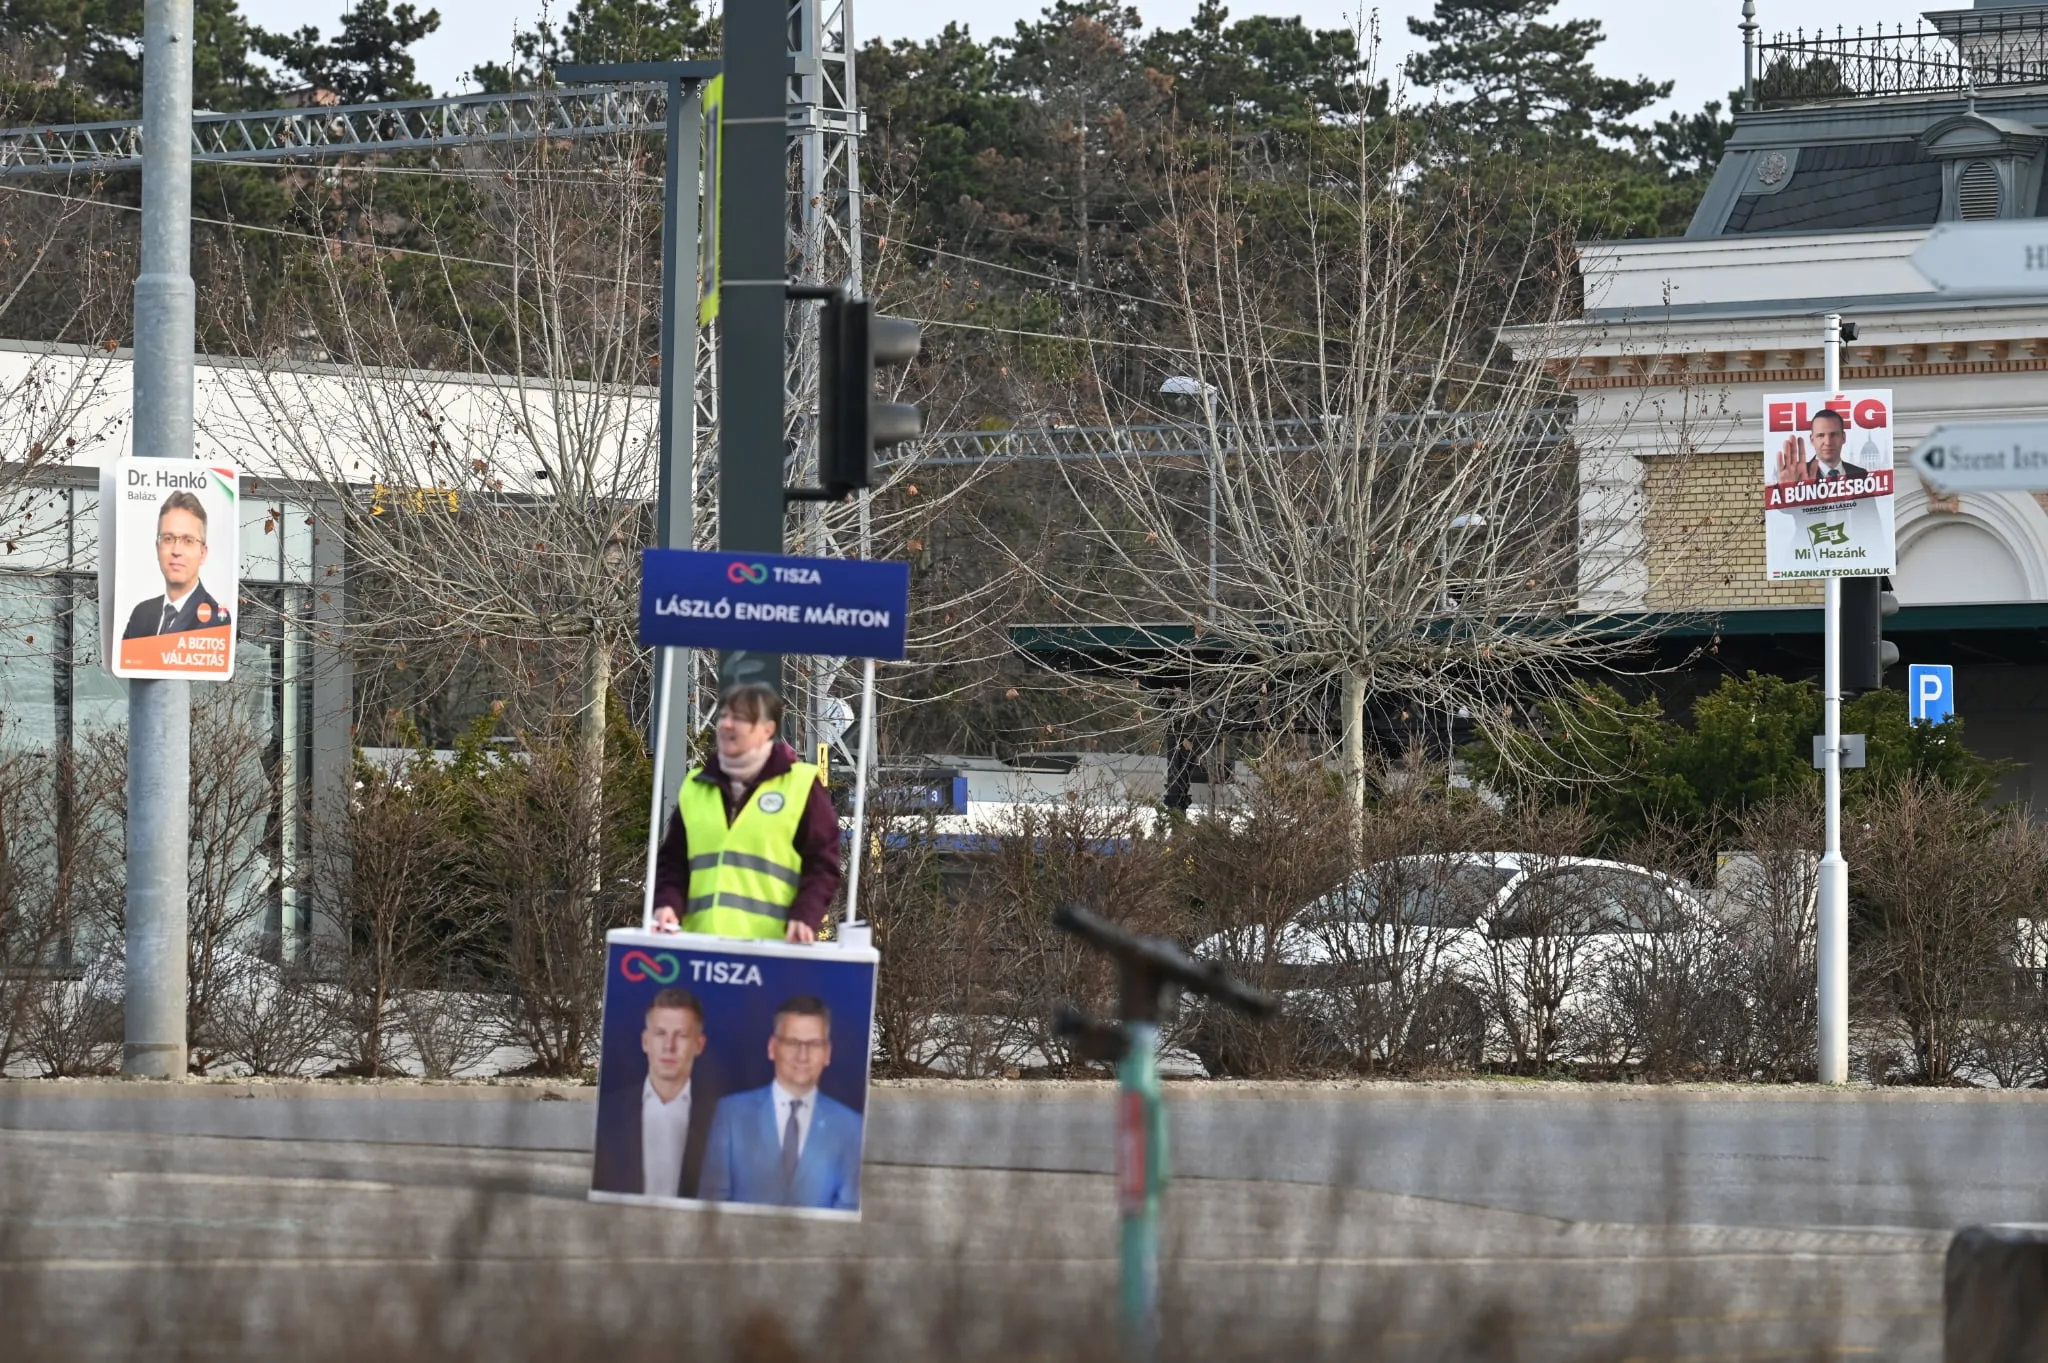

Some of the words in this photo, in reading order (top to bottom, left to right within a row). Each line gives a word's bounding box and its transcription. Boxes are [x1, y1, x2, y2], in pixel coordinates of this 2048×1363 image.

[1769, 395, 1887, 432] ELÉG
[128, 470, 151, 487] Dr.
[156, 470, 207, 489] Hankó
[128, 491, 157, 501] Balázs
[1770, 489, 1782, 505] A
[1784, 474, 1889, 503] BŰNÖZÉSBŐL!
[1836, 501, 1857, 509] LÁSZLÓ
[1795, 548, 1811, 560] Mi
[1819, 546, 1866, 559] Hazánk
[773, 567, 822, 584] TISZA
[655, 594, 729, 619] LÁSZLÓ
[734, 603, 800, 623] ENDRE
[804, 603, 890, 628] MÁRTON
[178, 637, 186, 649] A
[188, 637, 226, 651] BIZTOS
[161, 650, 225, 667] VÁLASZTÁS
[1919, 674, 1943, 719] P
[930, 790, 939, 802] 3
[689, 960, 764, 986] TISZA
